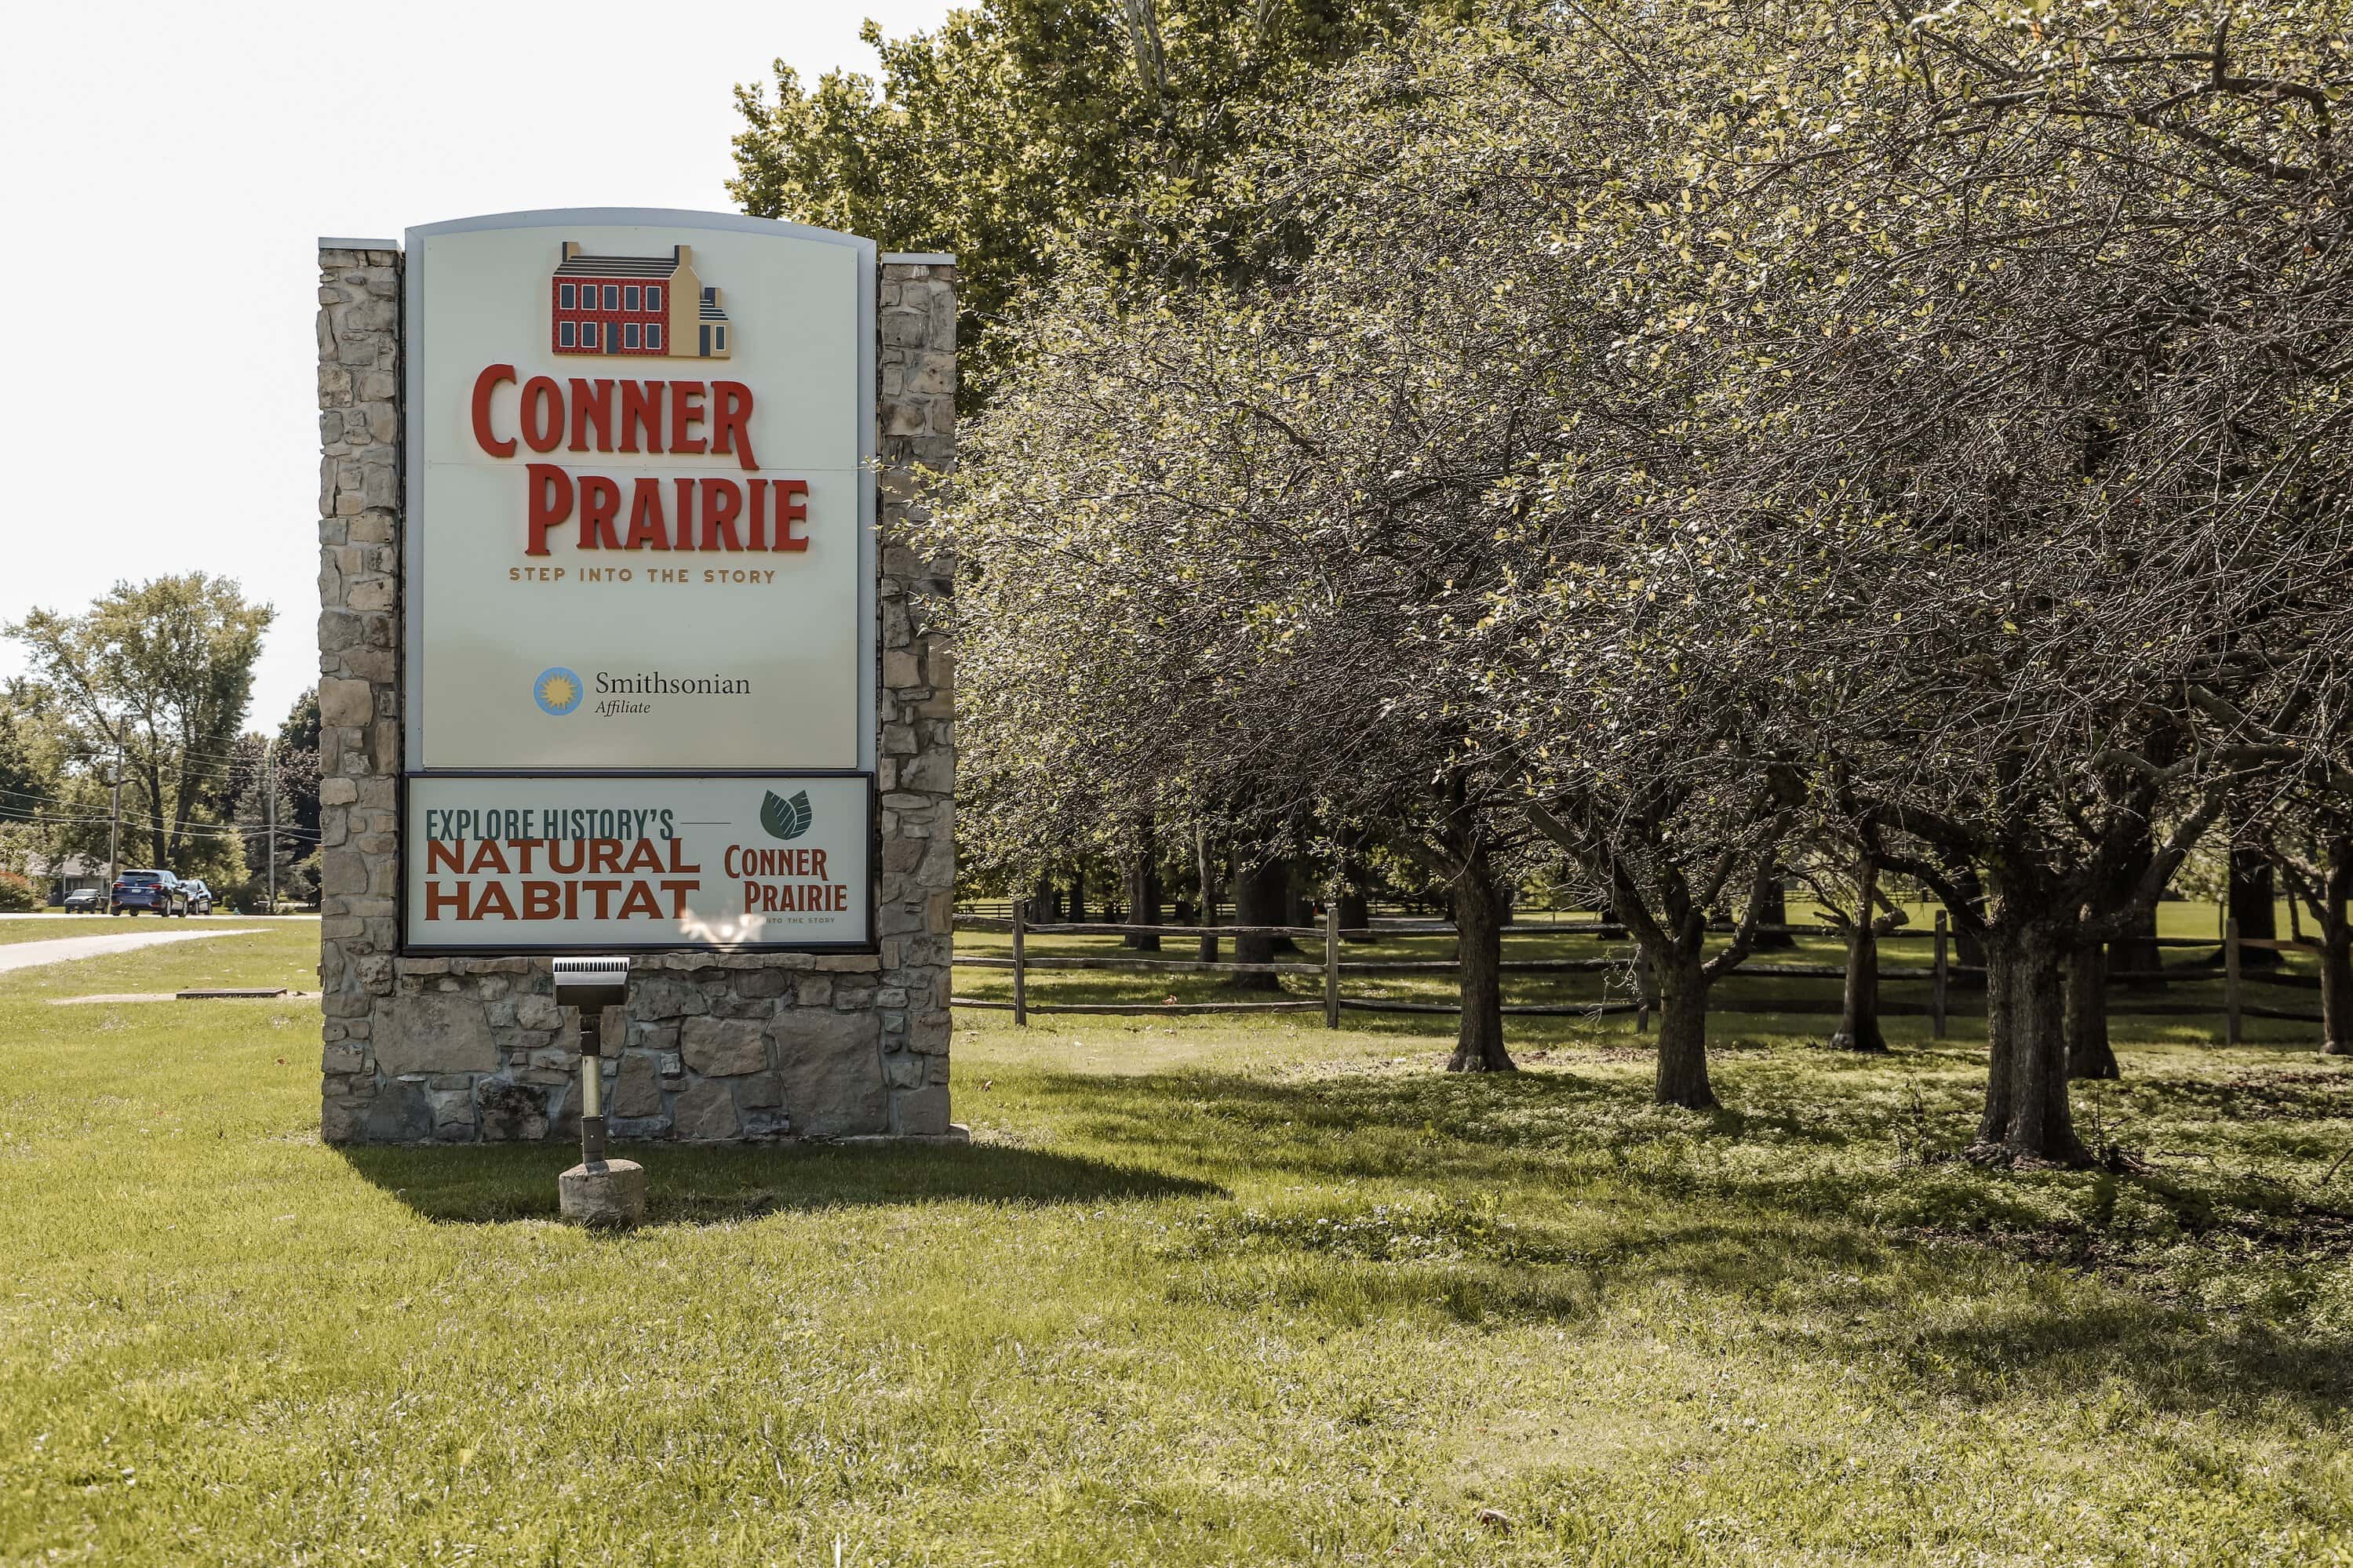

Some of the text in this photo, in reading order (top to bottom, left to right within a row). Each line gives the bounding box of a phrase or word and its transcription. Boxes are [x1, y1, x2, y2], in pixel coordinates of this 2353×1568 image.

[472, 364, 759, 471] CONNER
[525, 464, 810, 556] PRAIRIE
[508, 567, 777, 584] STEP INTO THE STORY
[596, 671, 752, 694] Smithsonian
[595, 700, 650, 717] Affiliate
[426, 809, 534, 841] EXPLORE
[426, 838, 701, 874] NATURAL
[724, 845, 829, 881] CONNER
[424, 880, 701, 921] HABITAT
[743, 881, 848, 914] PRAIRIE
